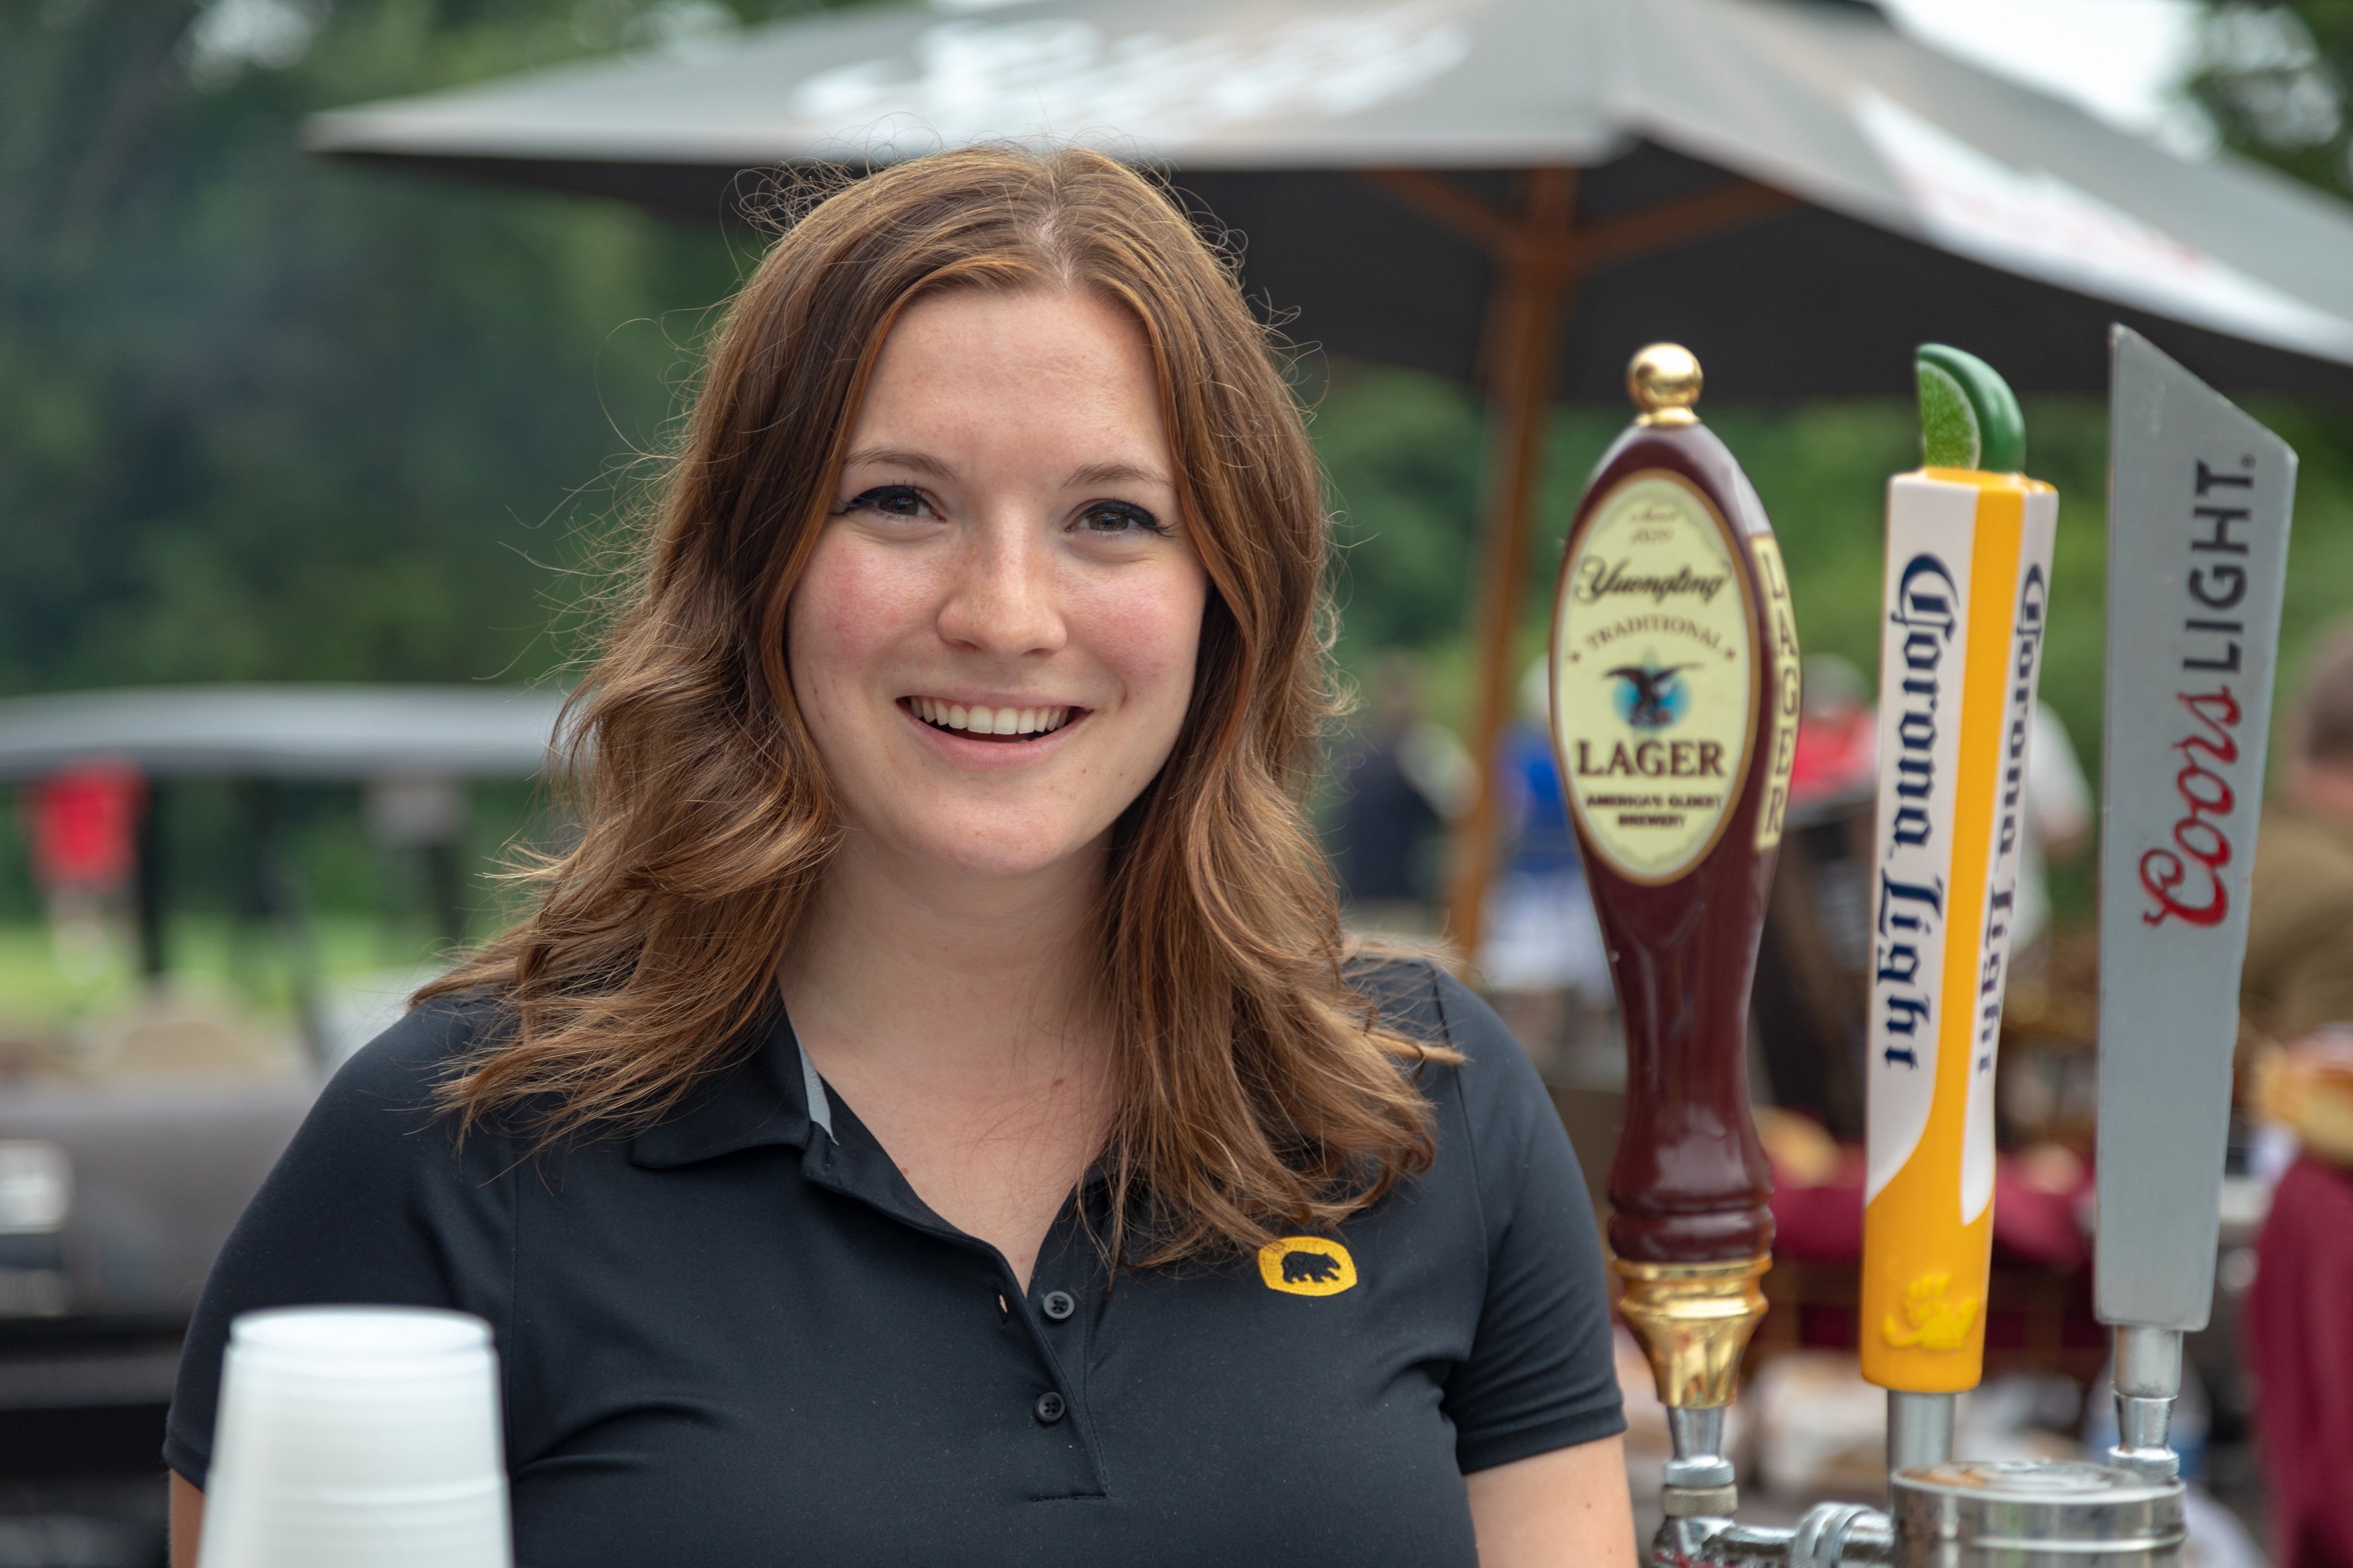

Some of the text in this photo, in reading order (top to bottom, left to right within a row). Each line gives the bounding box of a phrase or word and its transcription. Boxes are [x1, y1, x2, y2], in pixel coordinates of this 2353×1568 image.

[1574, 555, 1732, 604] Yuengling
[1585, 614, 1722, 650] TRADITIONAL
[1576, 740, 1726, 777] LAGER
[1761, 551, 1799, 834] LAGER
[1999, 563, 2046, 856] Corona
[2139, 458, 2254, 929] Coors LIGHT
[1618, 814, 1687, 827] BREWERY
[1876, 551, 1960, 1071] Corona Light
